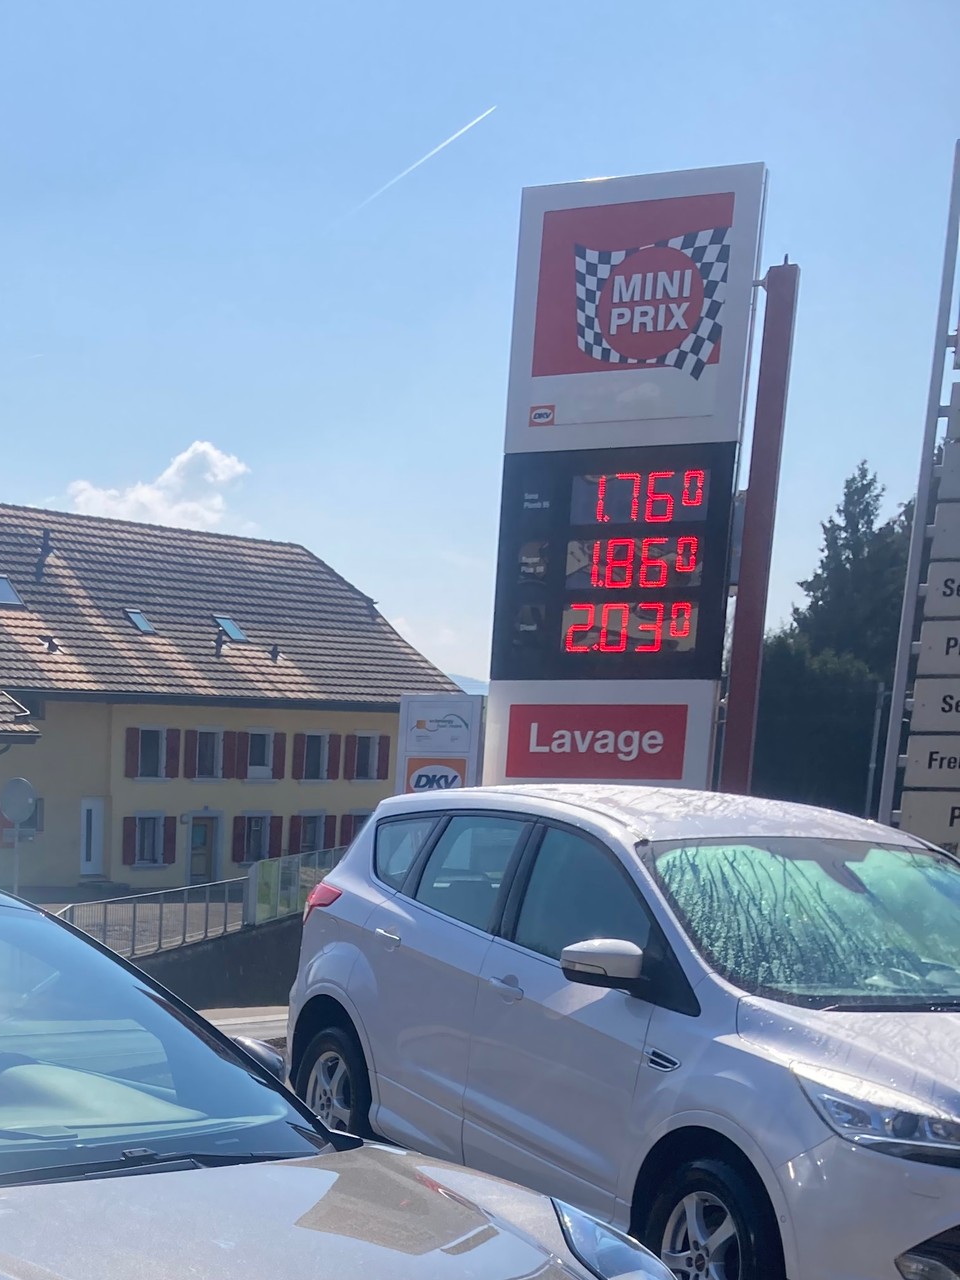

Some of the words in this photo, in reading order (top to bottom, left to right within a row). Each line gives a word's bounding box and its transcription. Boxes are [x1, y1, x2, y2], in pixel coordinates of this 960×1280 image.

[612, 269, 693, 303] MINI
[609, 302, 691, 336] PRIX
[944, 636, 960, 656] P
[528, 722, 665, 761] Lavage
[927, 750, 960, 770] Fre
[413, 774, 459, 789] DKV
